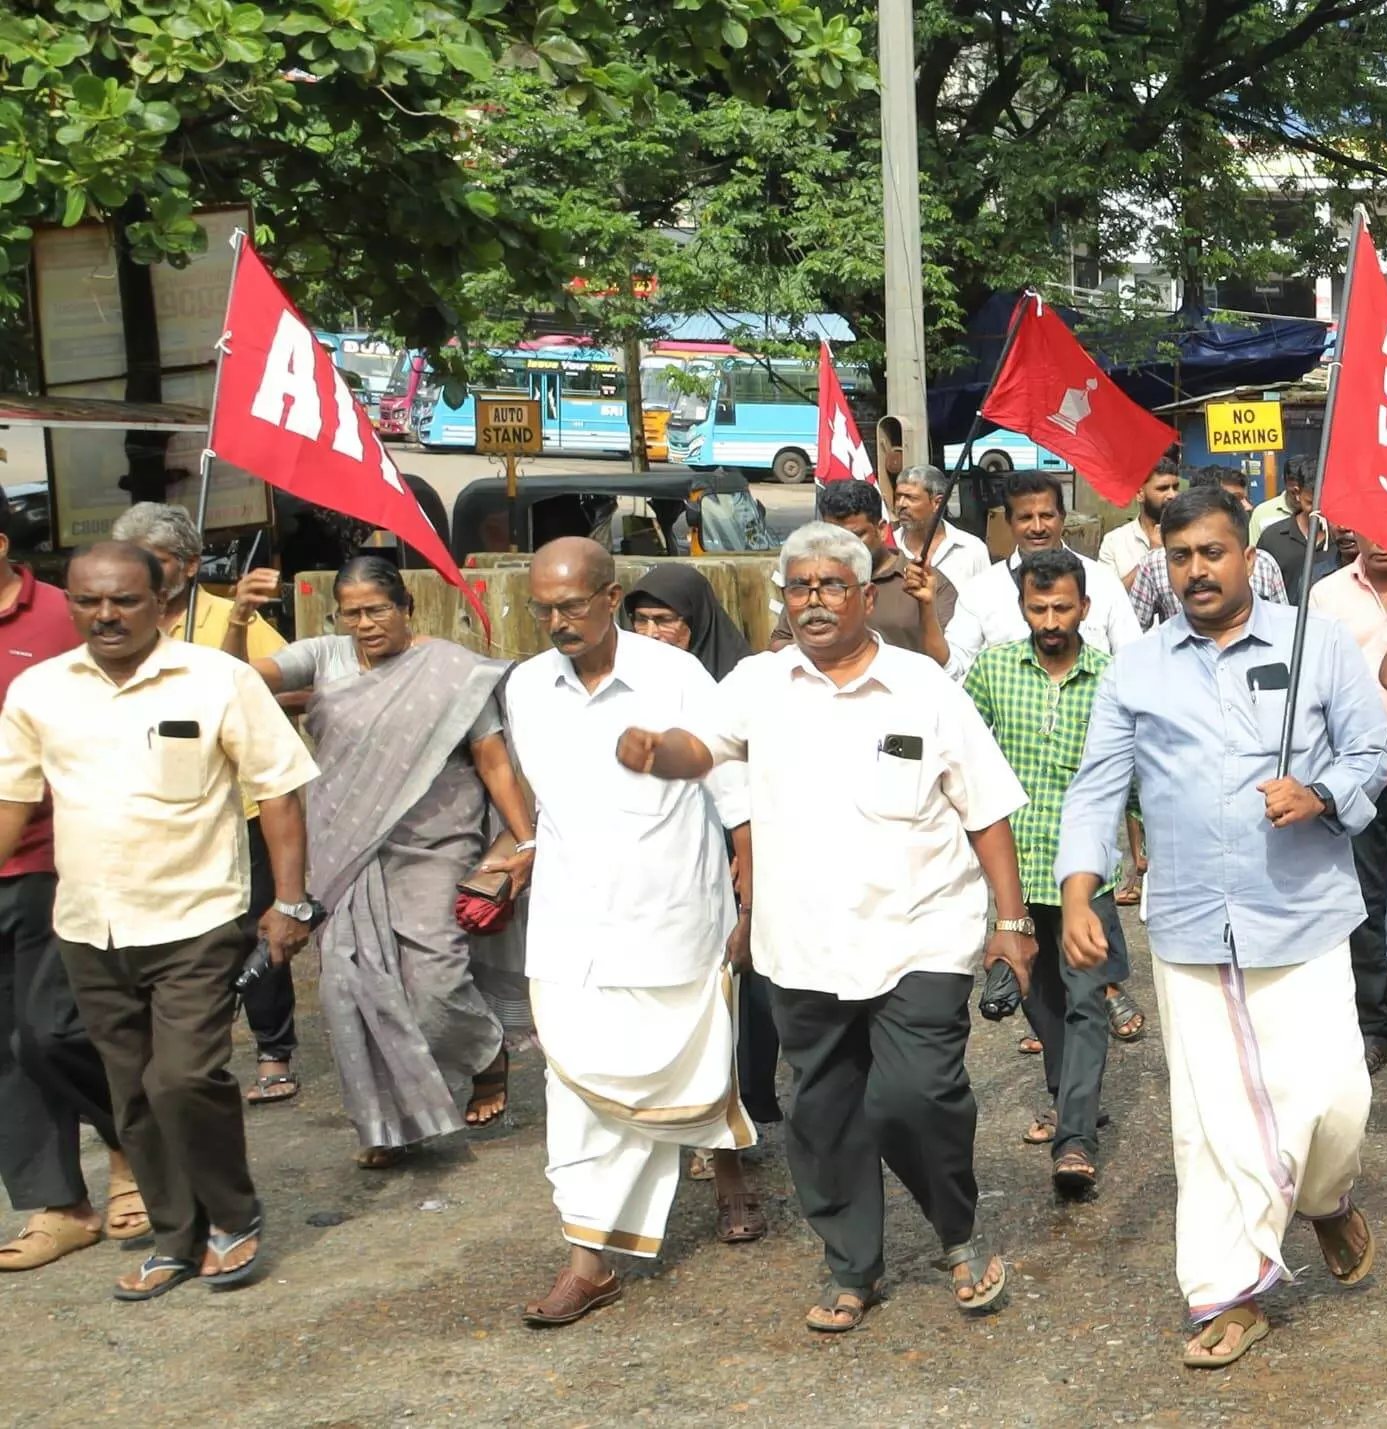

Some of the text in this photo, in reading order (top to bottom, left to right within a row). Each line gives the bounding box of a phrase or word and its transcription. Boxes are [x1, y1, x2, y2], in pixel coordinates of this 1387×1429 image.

[493, 407, 523, 424] AUTO
[1233, 409, 1255, 424] NO
[482, 426, 534, 445] STAND
[1213, 429, 1279, 446] PARKING
